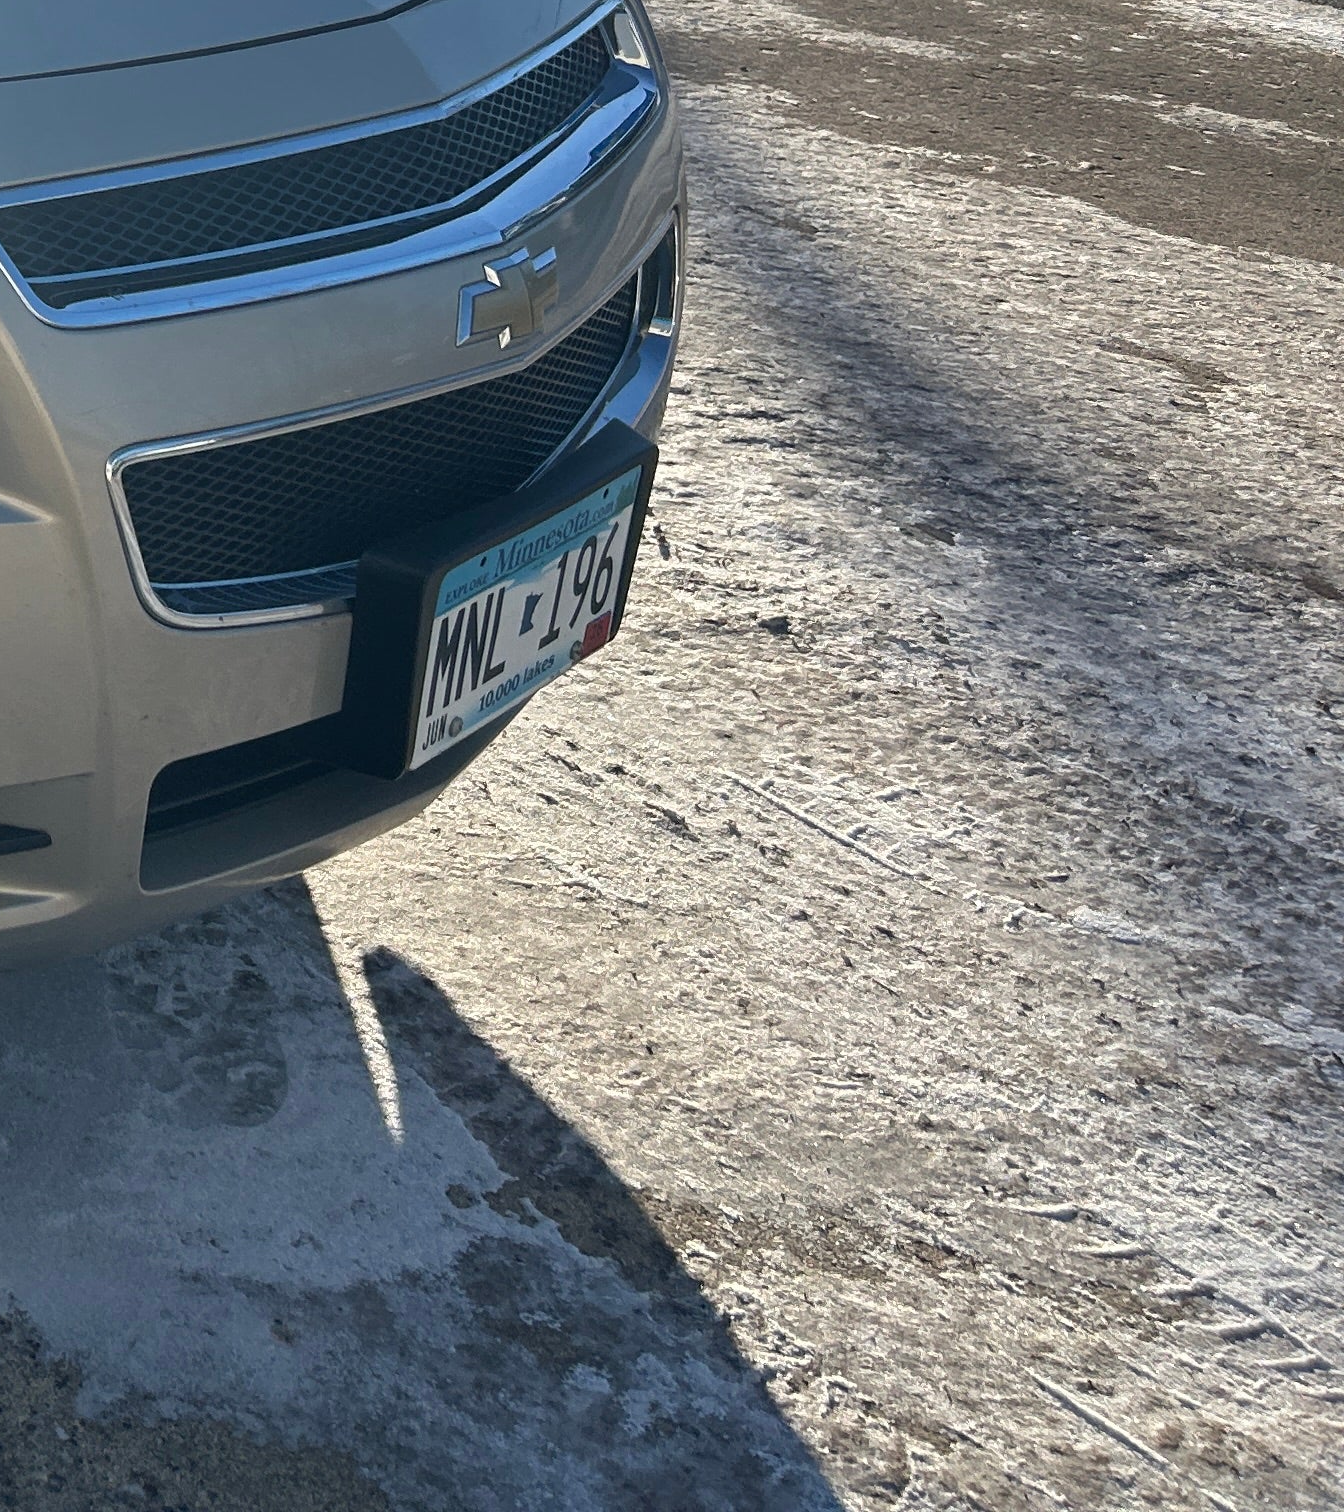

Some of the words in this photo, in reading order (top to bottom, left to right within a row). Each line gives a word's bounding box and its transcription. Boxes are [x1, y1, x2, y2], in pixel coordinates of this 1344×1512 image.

[494, 501, 615, 578] Minnesota.com
[425, 587, 506, 718] MNL
[538, 521, 620, 651] 196
[479, 673, 520, 712] 10,000
[522, 654, 555, 684] lakes
[422, 713, 448, 750] JUN
